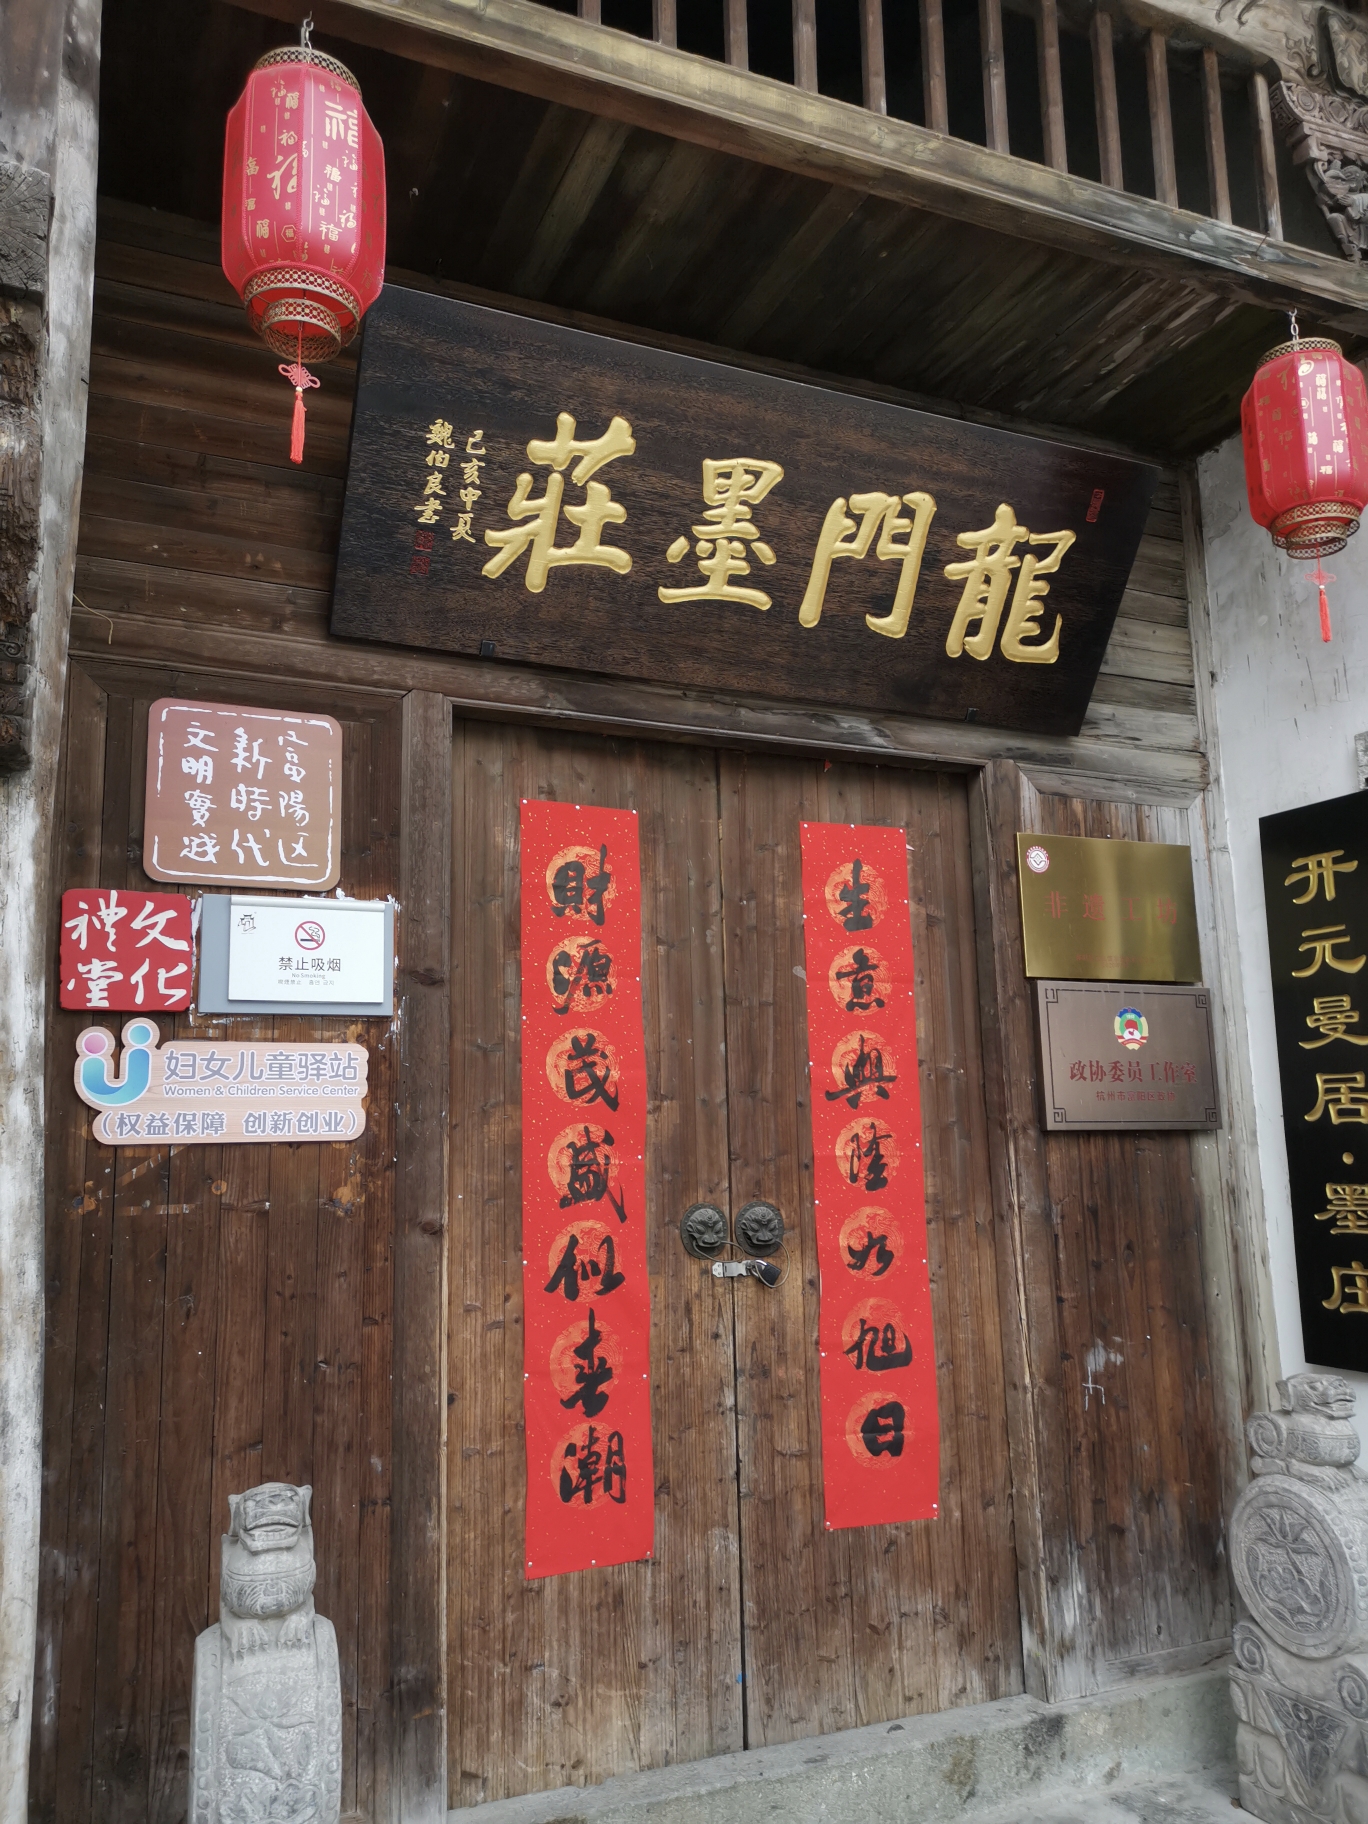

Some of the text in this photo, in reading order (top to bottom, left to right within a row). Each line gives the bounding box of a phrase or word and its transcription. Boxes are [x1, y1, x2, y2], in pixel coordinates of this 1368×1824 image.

[319, 221, 342, 241] 福
[130, 900, 190, 1006] 文化
[278, 956, 341, 972] 禁止吸烟
[163, 1050, 359, 1082] 妇女儿童驿站
[1069, 1060, 1197, 1083] 政协委员工作室
[164, 1085, 359, 1097] Women & Children Service Center
